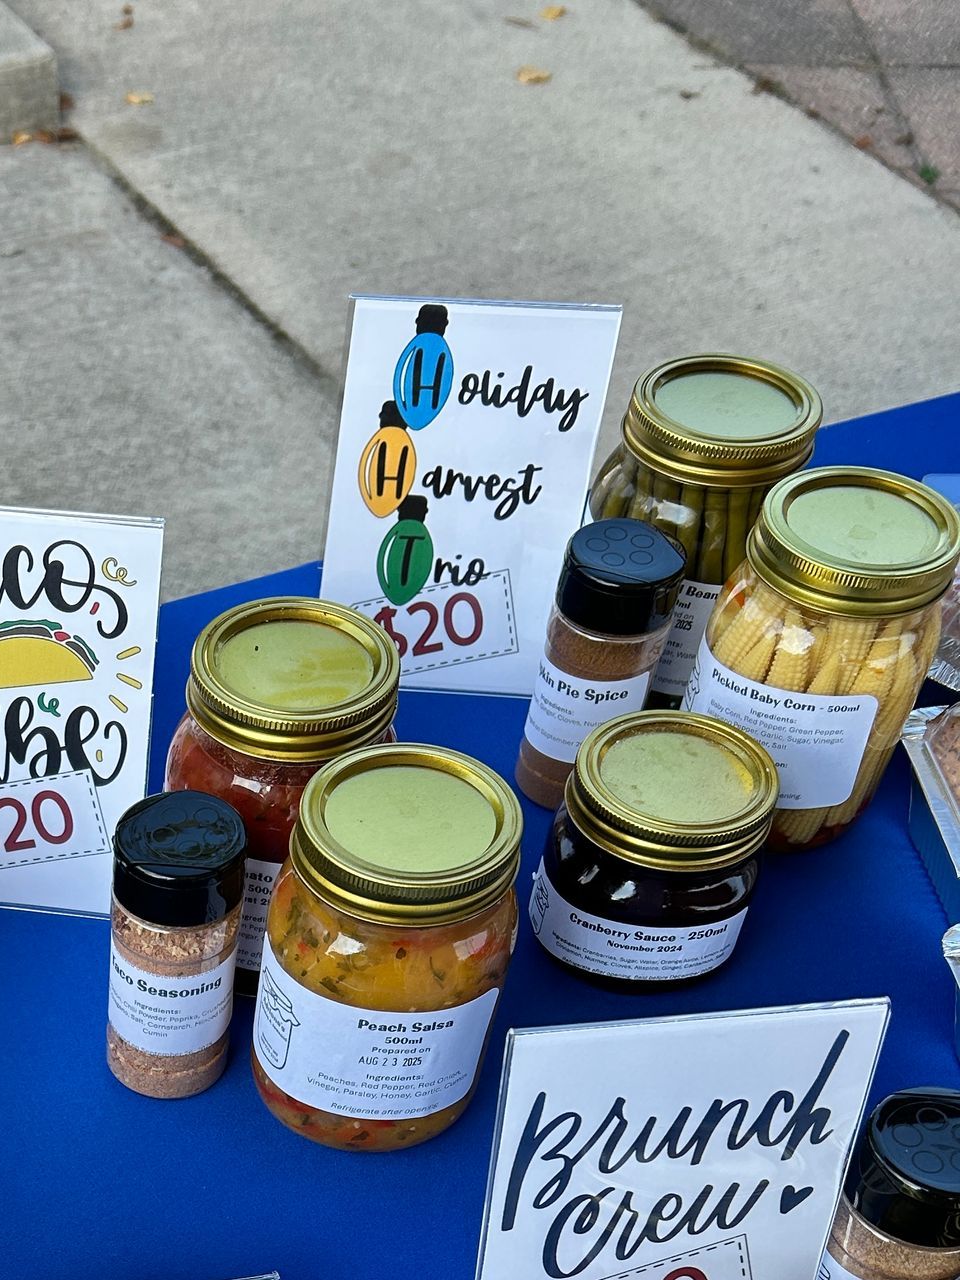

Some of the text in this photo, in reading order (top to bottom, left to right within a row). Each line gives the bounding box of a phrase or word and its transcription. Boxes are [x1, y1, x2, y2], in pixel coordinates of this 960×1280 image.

[412, 347, 589, 432] Holiday
[377, 441, 543, 520] Harvest
[399, 535, 490, 587] Trio
[373, 592, 484, 658] $20
[557, 679, 629, 705] Pie Spice
[711, 668, 860, 714] Pickled Baby Corn 500ml
[749, 707, 798, 724] Ingredients:
[744, 715, 758, 725] Red
[759, 720, 787, 733] Pepper,
[789, 726, 813, 736] Green
[814, 728, 844, 737] Pepper,
[786, 735, 812, 745] Sugar,
[569, 912, 728, 942] Cranberry Sauce 250ml
[606, 939, 683, 953] November 2024
[136, 977, 222, 998] Seasoning
[133, 999, 181, 1015] Ingredients:
[142, 1027, 168, 1038] Cumin
[357, 1019, 454, 1033] Peach Salsa
[371, 1046, 417, 1055] Prepared
[384, 1036, 423, 1045] 500ml
[358, 1056, 423, 1067] AUG 2025
[307, 1076, 341, 1094] Vinegar,
[343, 1088, 378, 1099] Parsley,
[318, 1071, 436, 1091] Peaches, Red Pepper, Red
[366, 1073, 424, 1083] Ingredients:
[330, 1102, 403, 1116] Refrigerate after
[501, 1029, 850, 1232] Brunch
[542, 1179, 769, 1279] Crew
